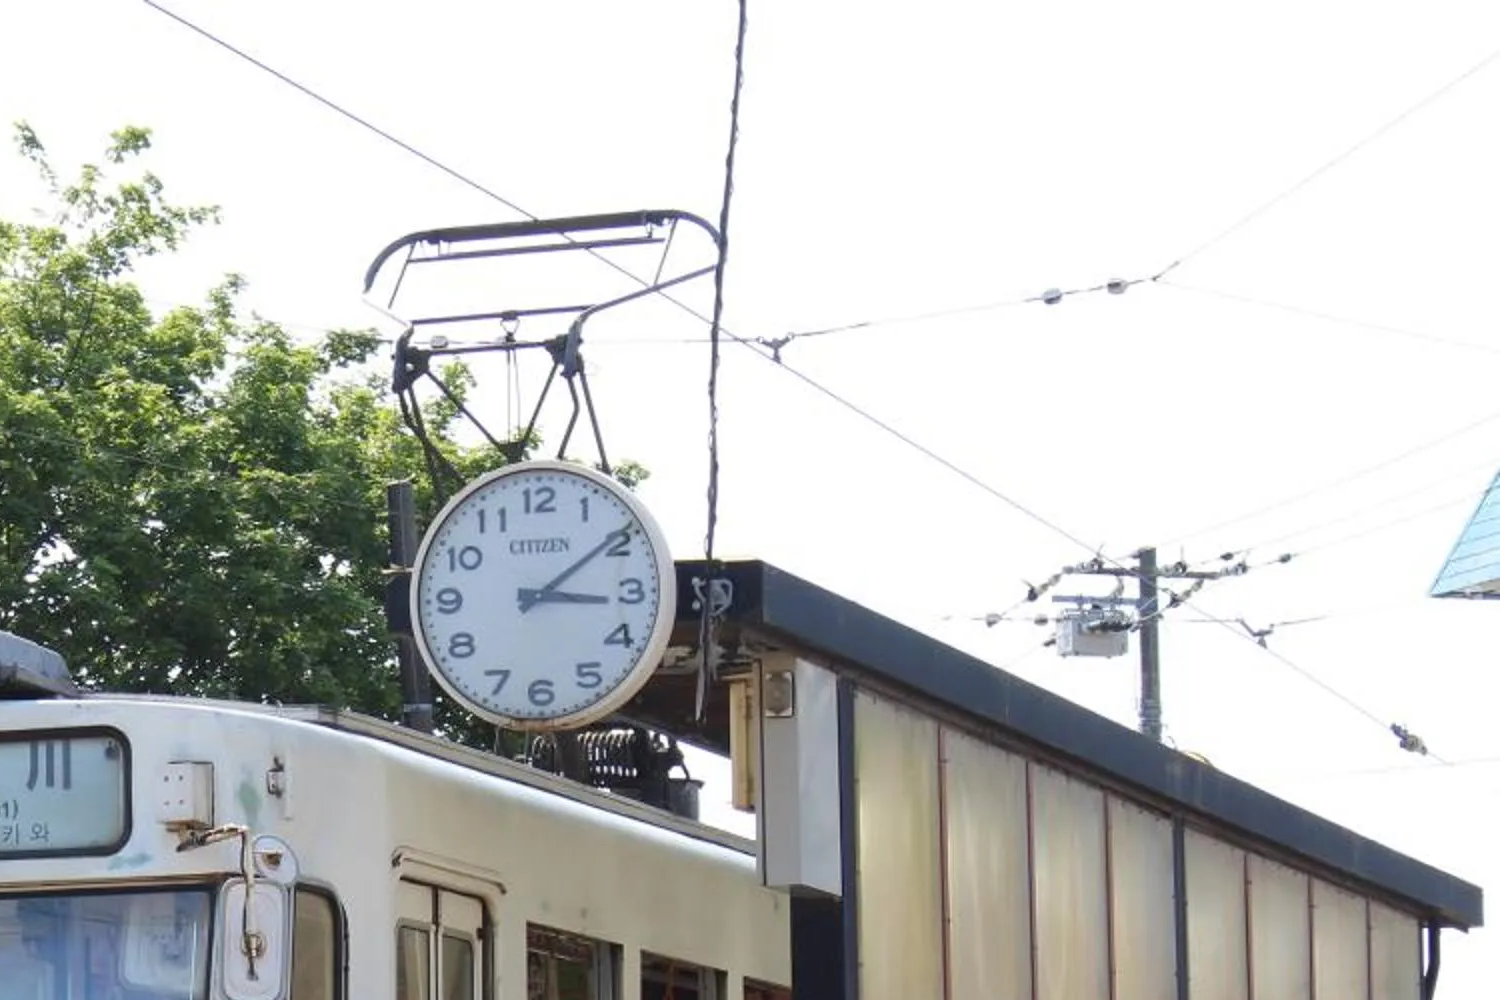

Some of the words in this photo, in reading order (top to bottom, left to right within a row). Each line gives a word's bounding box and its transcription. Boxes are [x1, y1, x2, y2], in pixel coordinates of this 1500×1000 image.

[522, 486, 557, 514] 12
[580, 497, 589, 522] 1
[477, 507, 506, 534] 11
[509, 537, 571, 555] CITIZEN
[605, 530, 631, 557] 2
[448, 546, 483, 572] 10
[436, 588, 463, 614] 9
[618, 578, 645, 604] 3
[449, 632, 476, 658] 8
[603, 623, 634, 648] 4
[484, 670, 512, 695] 7
[576, 662, 603, 688] 5
[528, 679, 555, 706] 6
